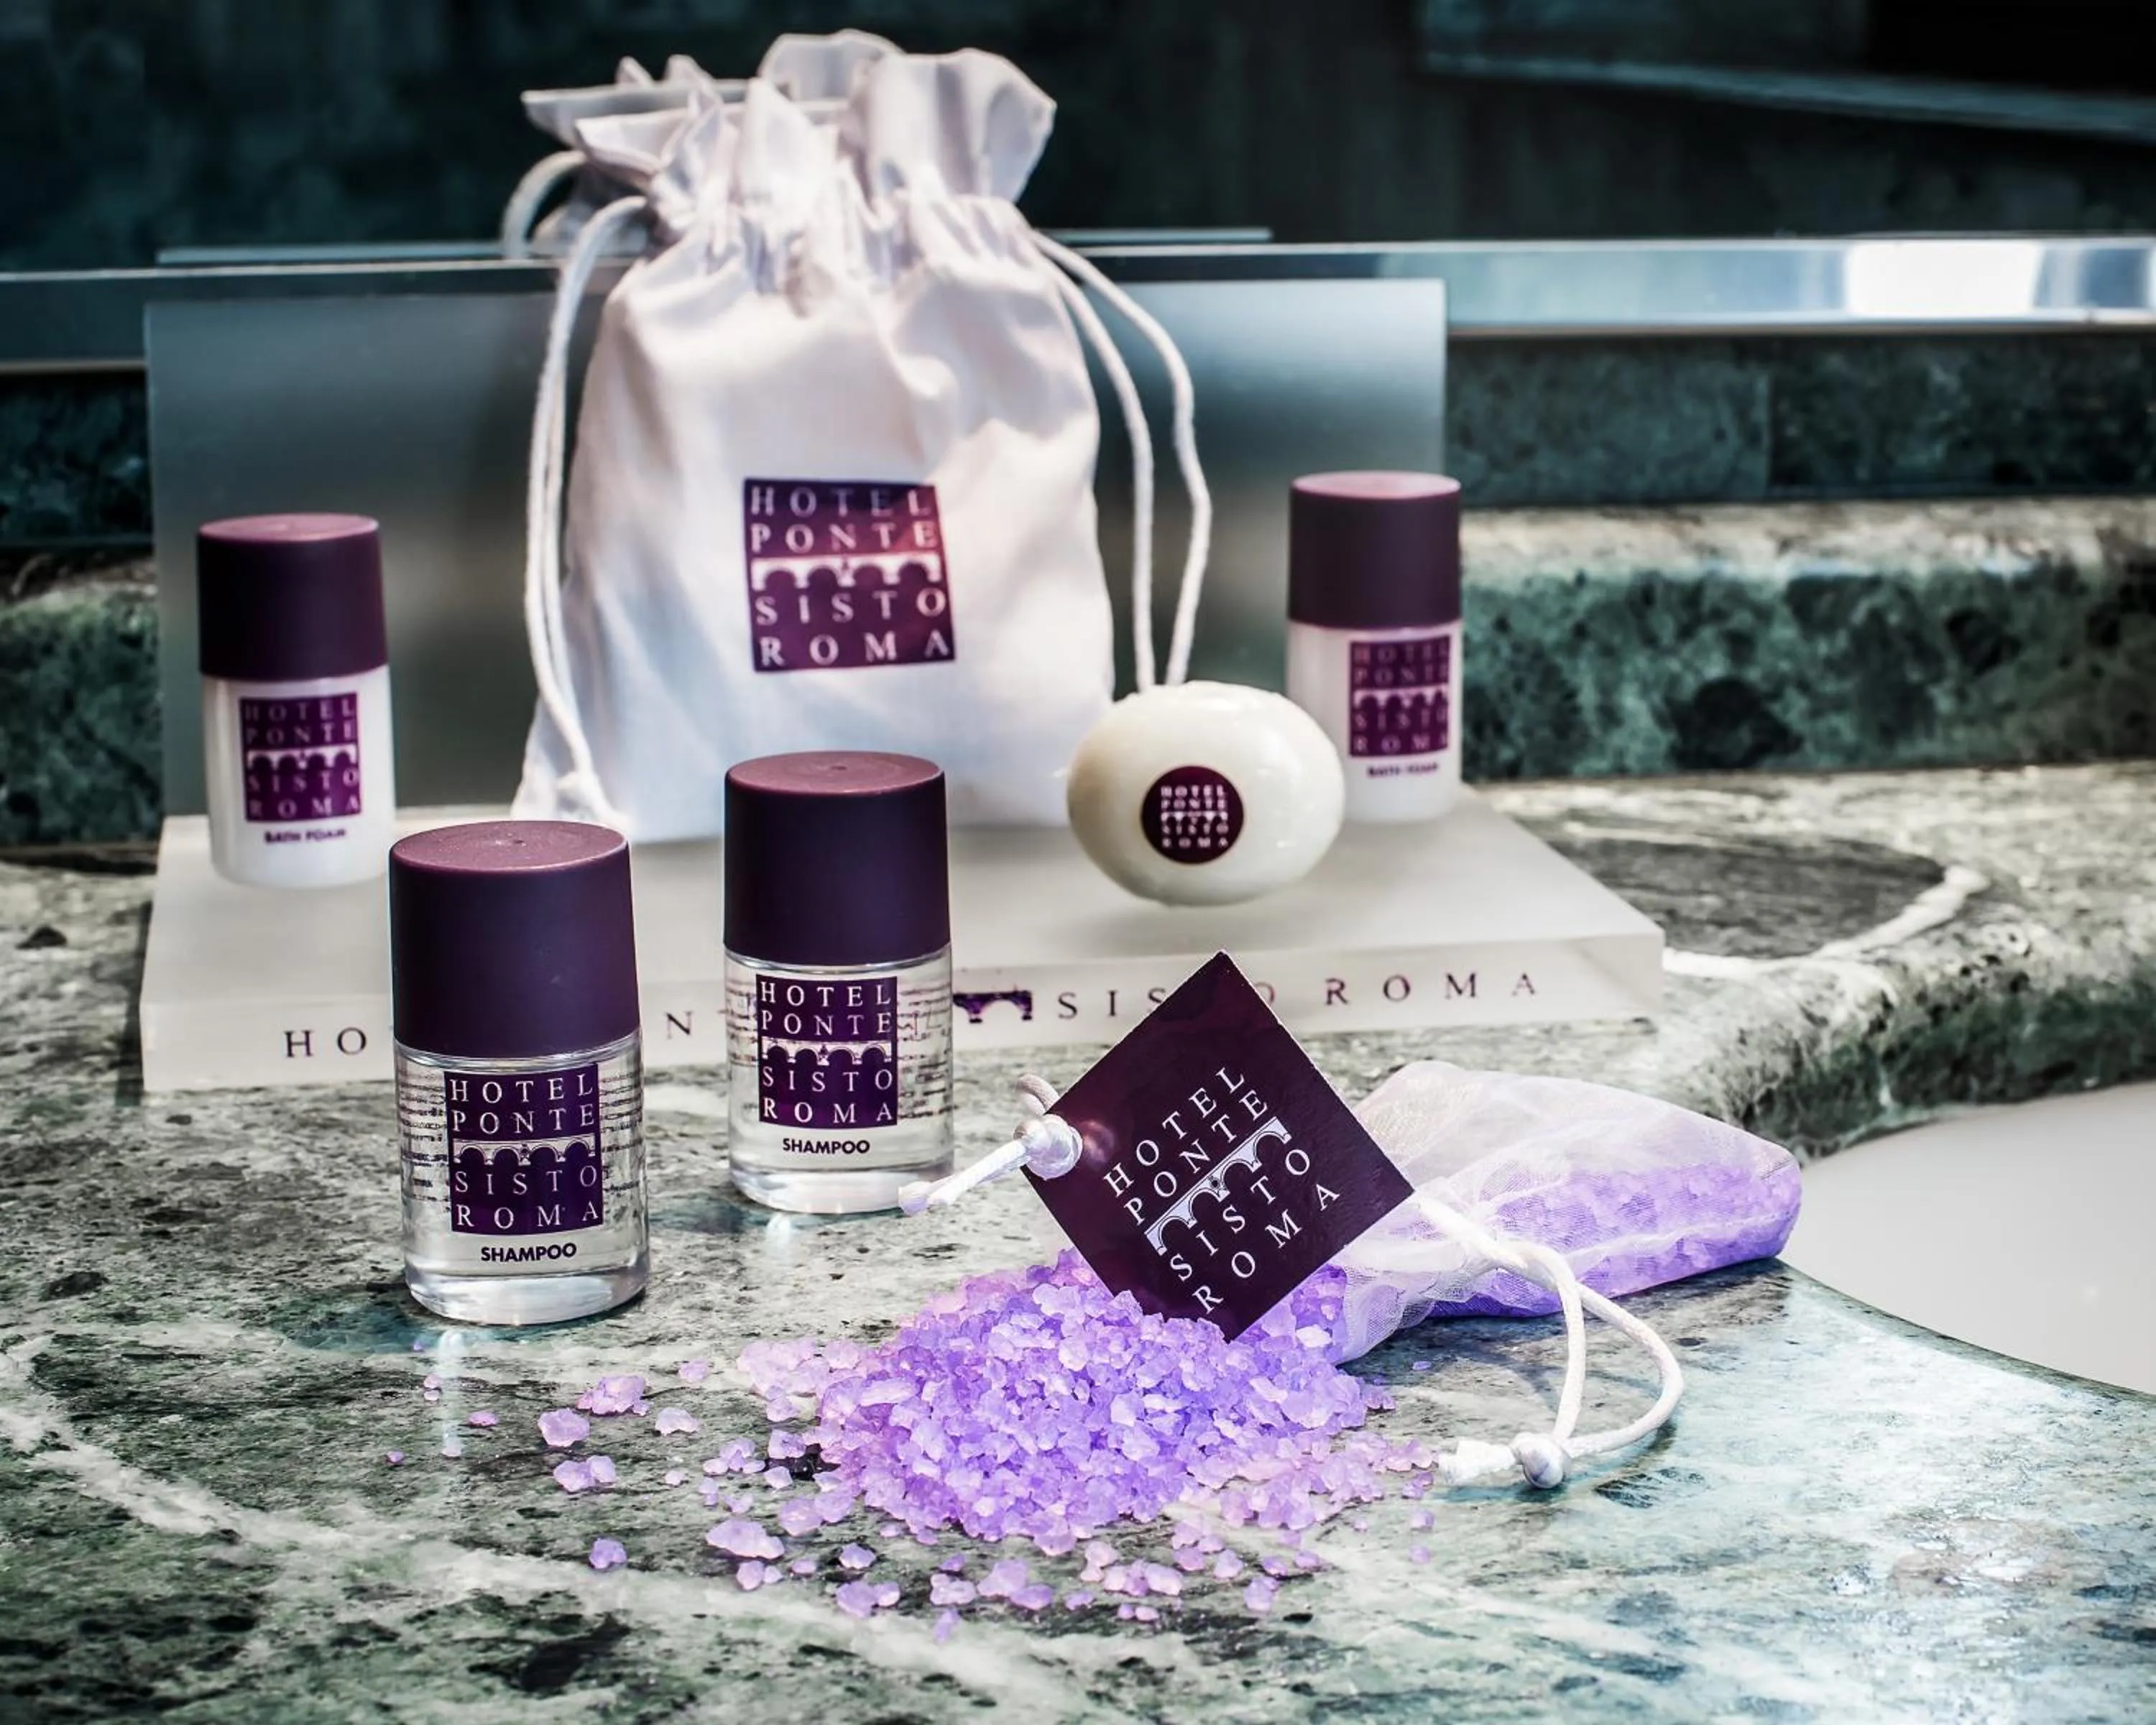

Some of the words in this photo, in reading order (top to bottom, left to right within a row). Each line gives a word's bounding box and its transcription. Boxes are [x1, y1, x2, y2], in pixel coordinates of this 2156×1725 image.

[751, 486, 931, 517] HOTEL
[751, 520, 938, 553] PONTE
[755, 587, 946, 625] SISTO
[760, 629, 949, 666] ROMA
[245, 698, 355, 722] HOTEL
[246, 720, 355, 745] PONTE
[249, 768, 359, 792] SISTO
[1161, 784, 1227, 798] HOTEL
[249, 795, 359, 818] ROMA
[1161, 799, 1226, 809] PONTE
[1162, 822, 1229, 835] SISTO
[1162, 837, 1228, 848] ROMA
[760, 981, 890, 1007] HOTEL
[1325, 972, 1537, 1006] ROMA
[761, 1010, 892, 1035] PONTE
[450, 1074, 593, 1103] HOTEL
[762, 1067, 893, 1092] SISTO
[452, 1104, 595, 1133] PONTE
[763, 1098, 893, 1123] ROMA
[1103, 1067, 1245, 1197] HOTEL
[783, 1138, 870, 1154] SHAMPOO
[1123, 1090, 1268, 1225] PONTE
[454, 1165, 597, 1195] SISTO
[456, 1201, 598, 1229] ROMA
[1169, 1149, 1310, 1282] SISTO
[481, 1243, 576, 1262] SHAMPOO
[1192, 1183, 1340, 1314] ROMA
